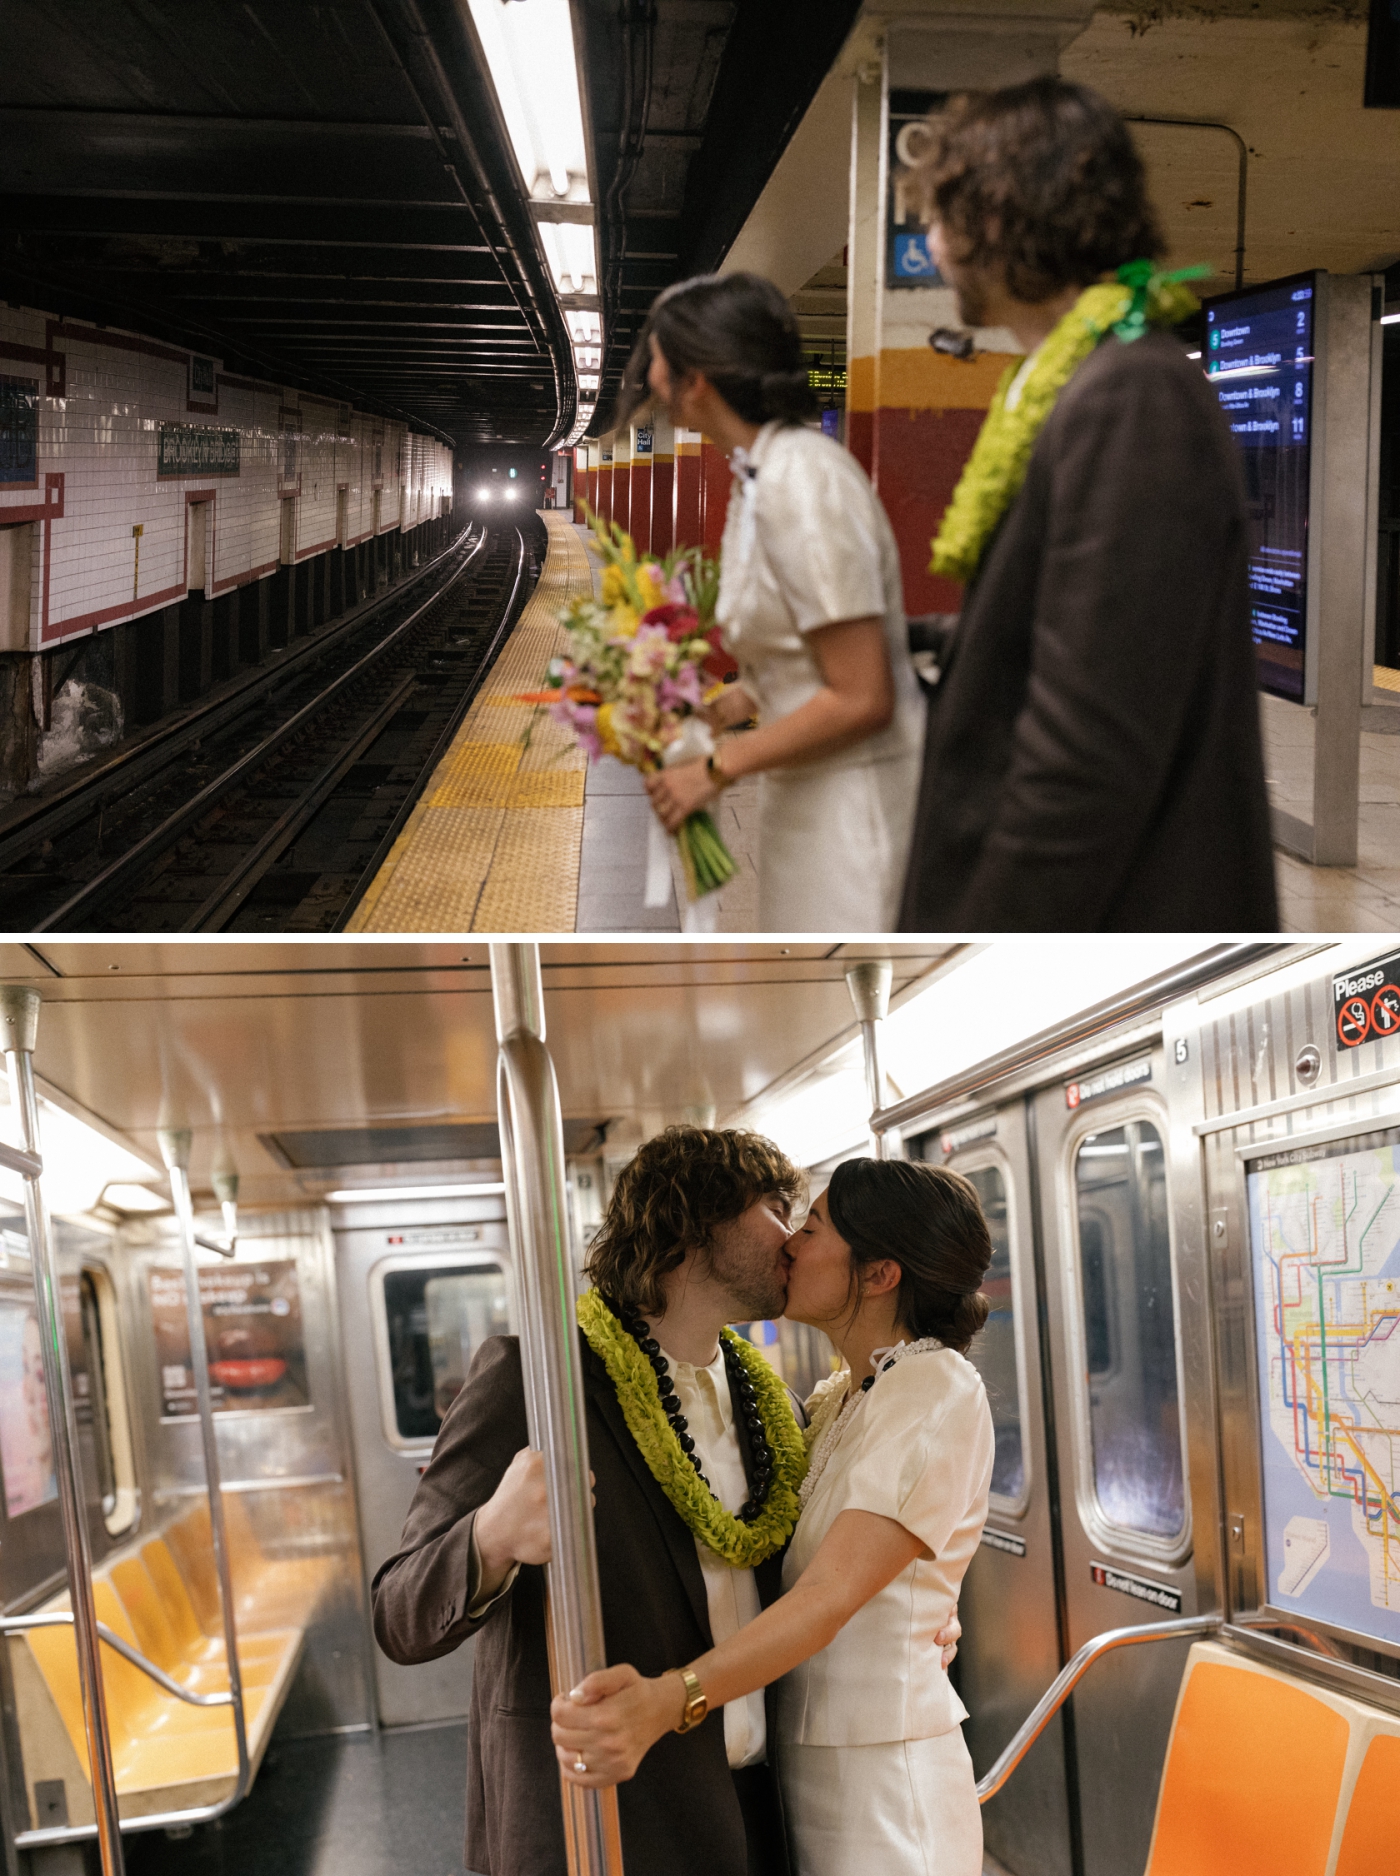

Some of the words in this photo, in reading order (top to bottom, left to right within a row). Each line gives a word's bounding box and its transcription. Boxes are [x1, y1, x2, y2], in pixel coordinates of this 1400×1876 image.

[1297, 311, 1306, 328] 2
[1212, 333, 1218, 347] 5
[1220, 326, 1251, 339] Downtown
[1220, 359, 1249, 371] Downtown
[1254, 352, 1281, 365] Brooklyn
[1219, 390, 1248, 402] Downtown
[1253, 386, 1281, 399] Brooklyn
[1295, 382, 1303, 398] 8
[1253, 419, 1280, 433] Brooklyn
[1292, 417, 1304, 433] 11
[163, 434, 209, 468] BROOKLYN
[209, 436, 236, 467] BRIDGE
[1335, 970, 1385, 1002] Please
[1263, 1156, 1276, 1168] New
[1276, 1153, 1289, 1166] York
[1289, 1152, 1303, 1165] City
[1303, 1149, 1327, 1162] Subway
